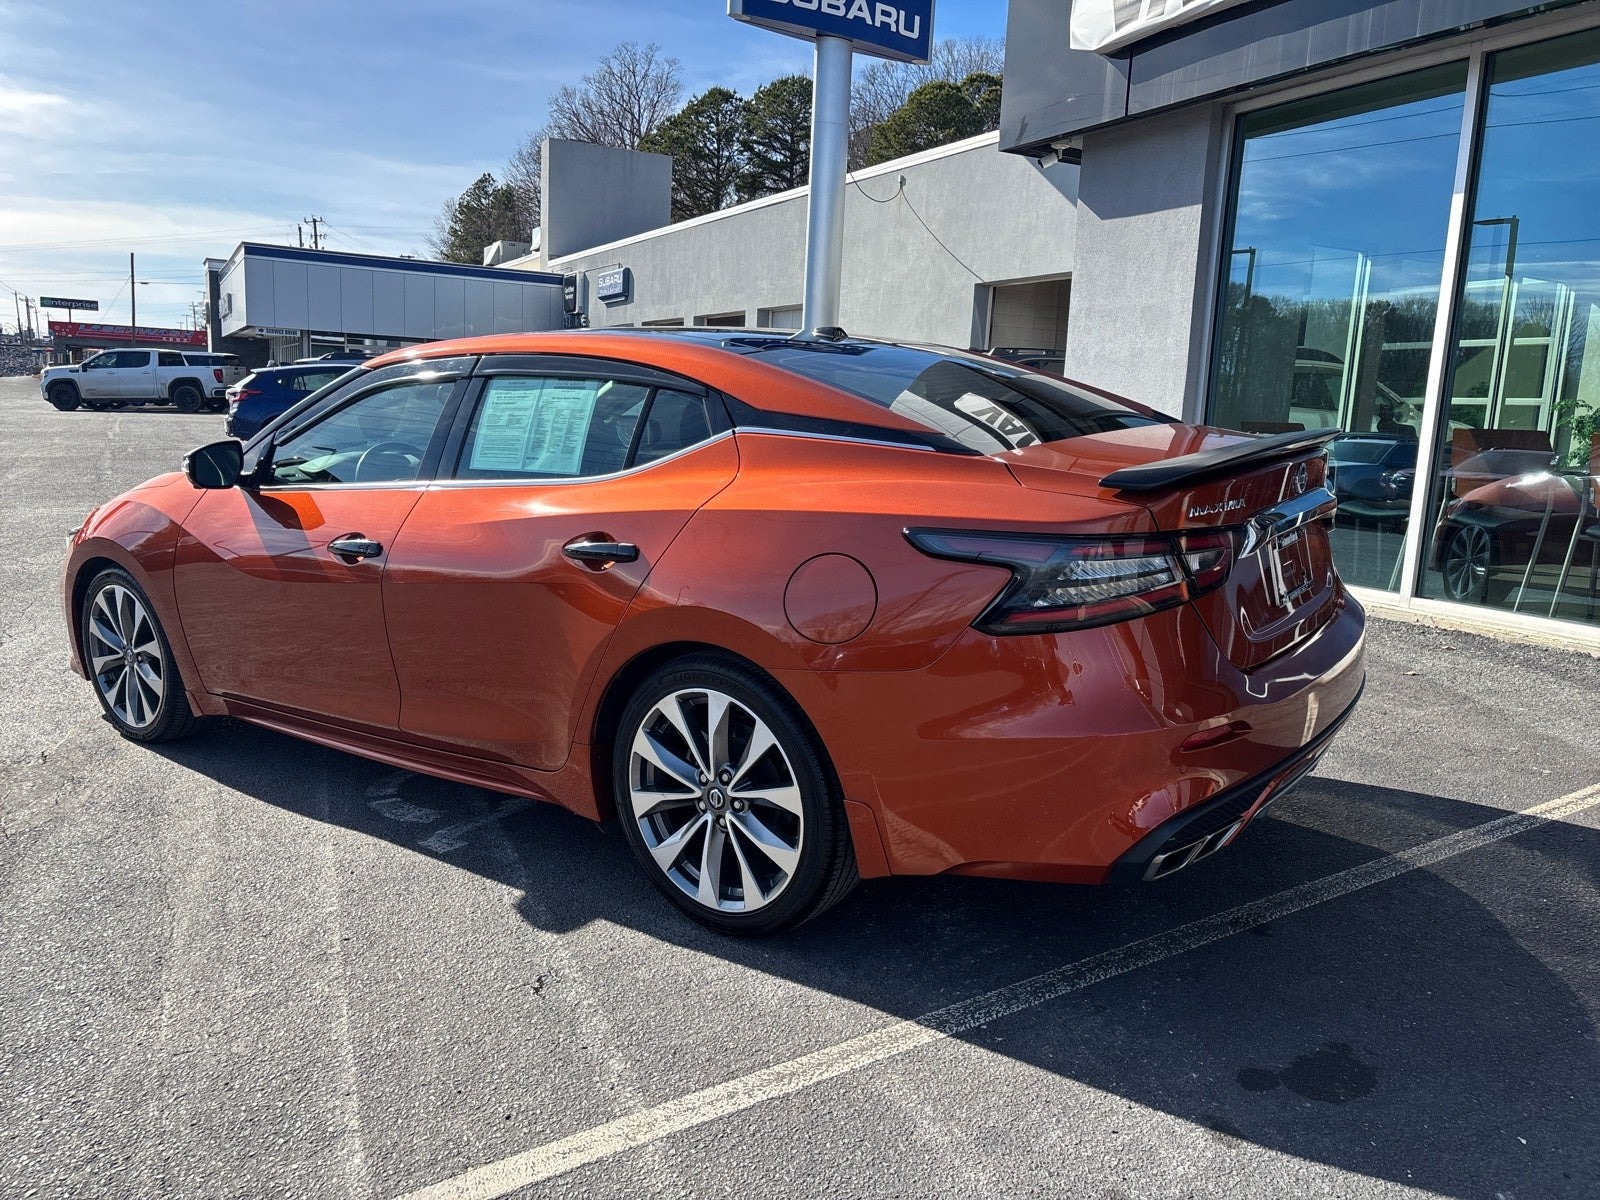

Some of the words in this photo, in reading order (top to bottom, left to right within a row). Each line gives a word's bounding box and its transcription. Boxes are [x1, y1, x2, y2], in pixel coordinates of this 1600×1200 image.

[598, 274, 623, 287] SUBARU
[43, 299, 98, 308] enterprise
[1189, 499, 1246, 517] MAXIMA
